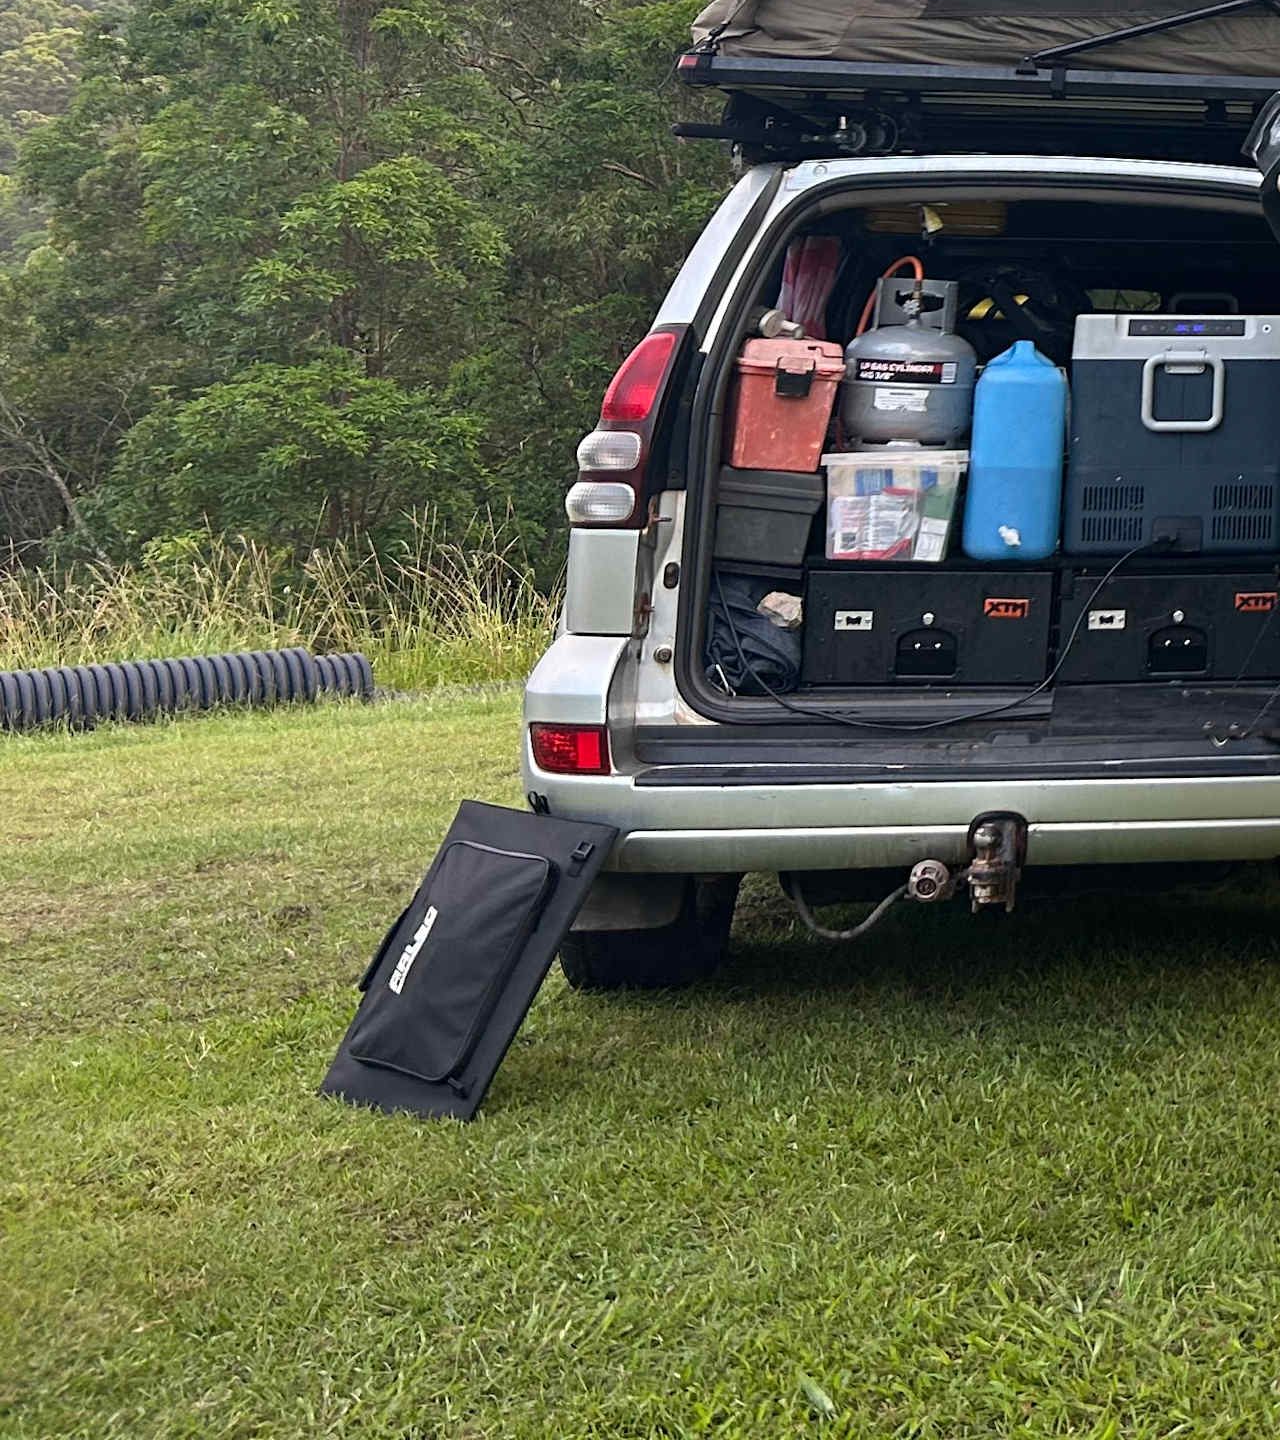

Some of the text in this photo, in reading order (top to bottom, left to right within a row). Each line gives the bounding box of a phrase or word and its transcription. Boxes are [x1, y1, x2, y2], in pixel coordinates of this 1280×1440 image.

[870, 362, 888, 372] GAS
[888, 363, 935, 375] CYLINDER
[985, 601, 1027, 618] XTM
